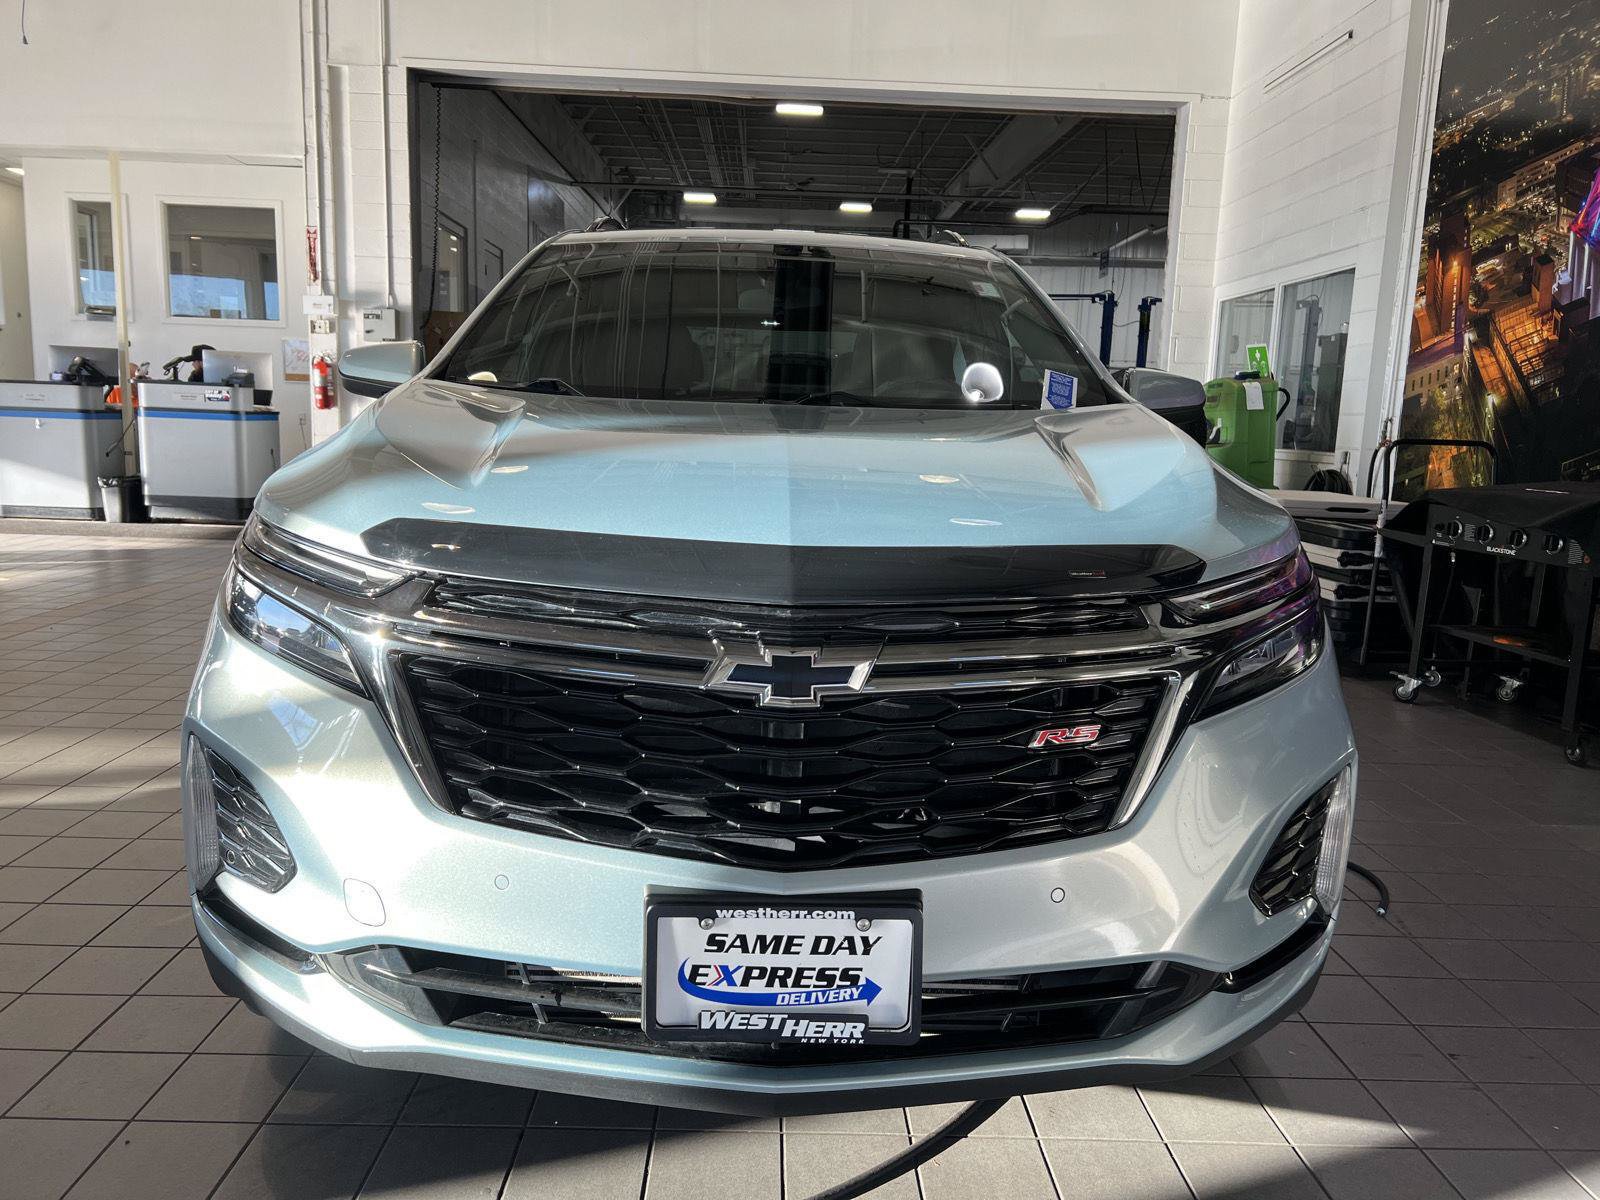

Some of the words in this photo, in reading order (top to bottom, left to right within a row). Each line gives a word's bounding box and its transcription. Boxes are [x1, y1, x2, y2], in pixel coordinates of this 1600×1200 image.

[1486, 546, 1516, 556] BLACKSTONE
[1031, 724, 1102, 747] RS
[715, 907, 856, 920] westherr.com
[703, 933, 806, 956] SAME
[808, 935, 883, 957] DAY
[687, 964, 864, 989] EXPRESS
[775, 986, 864, 1007] DELIVERY
